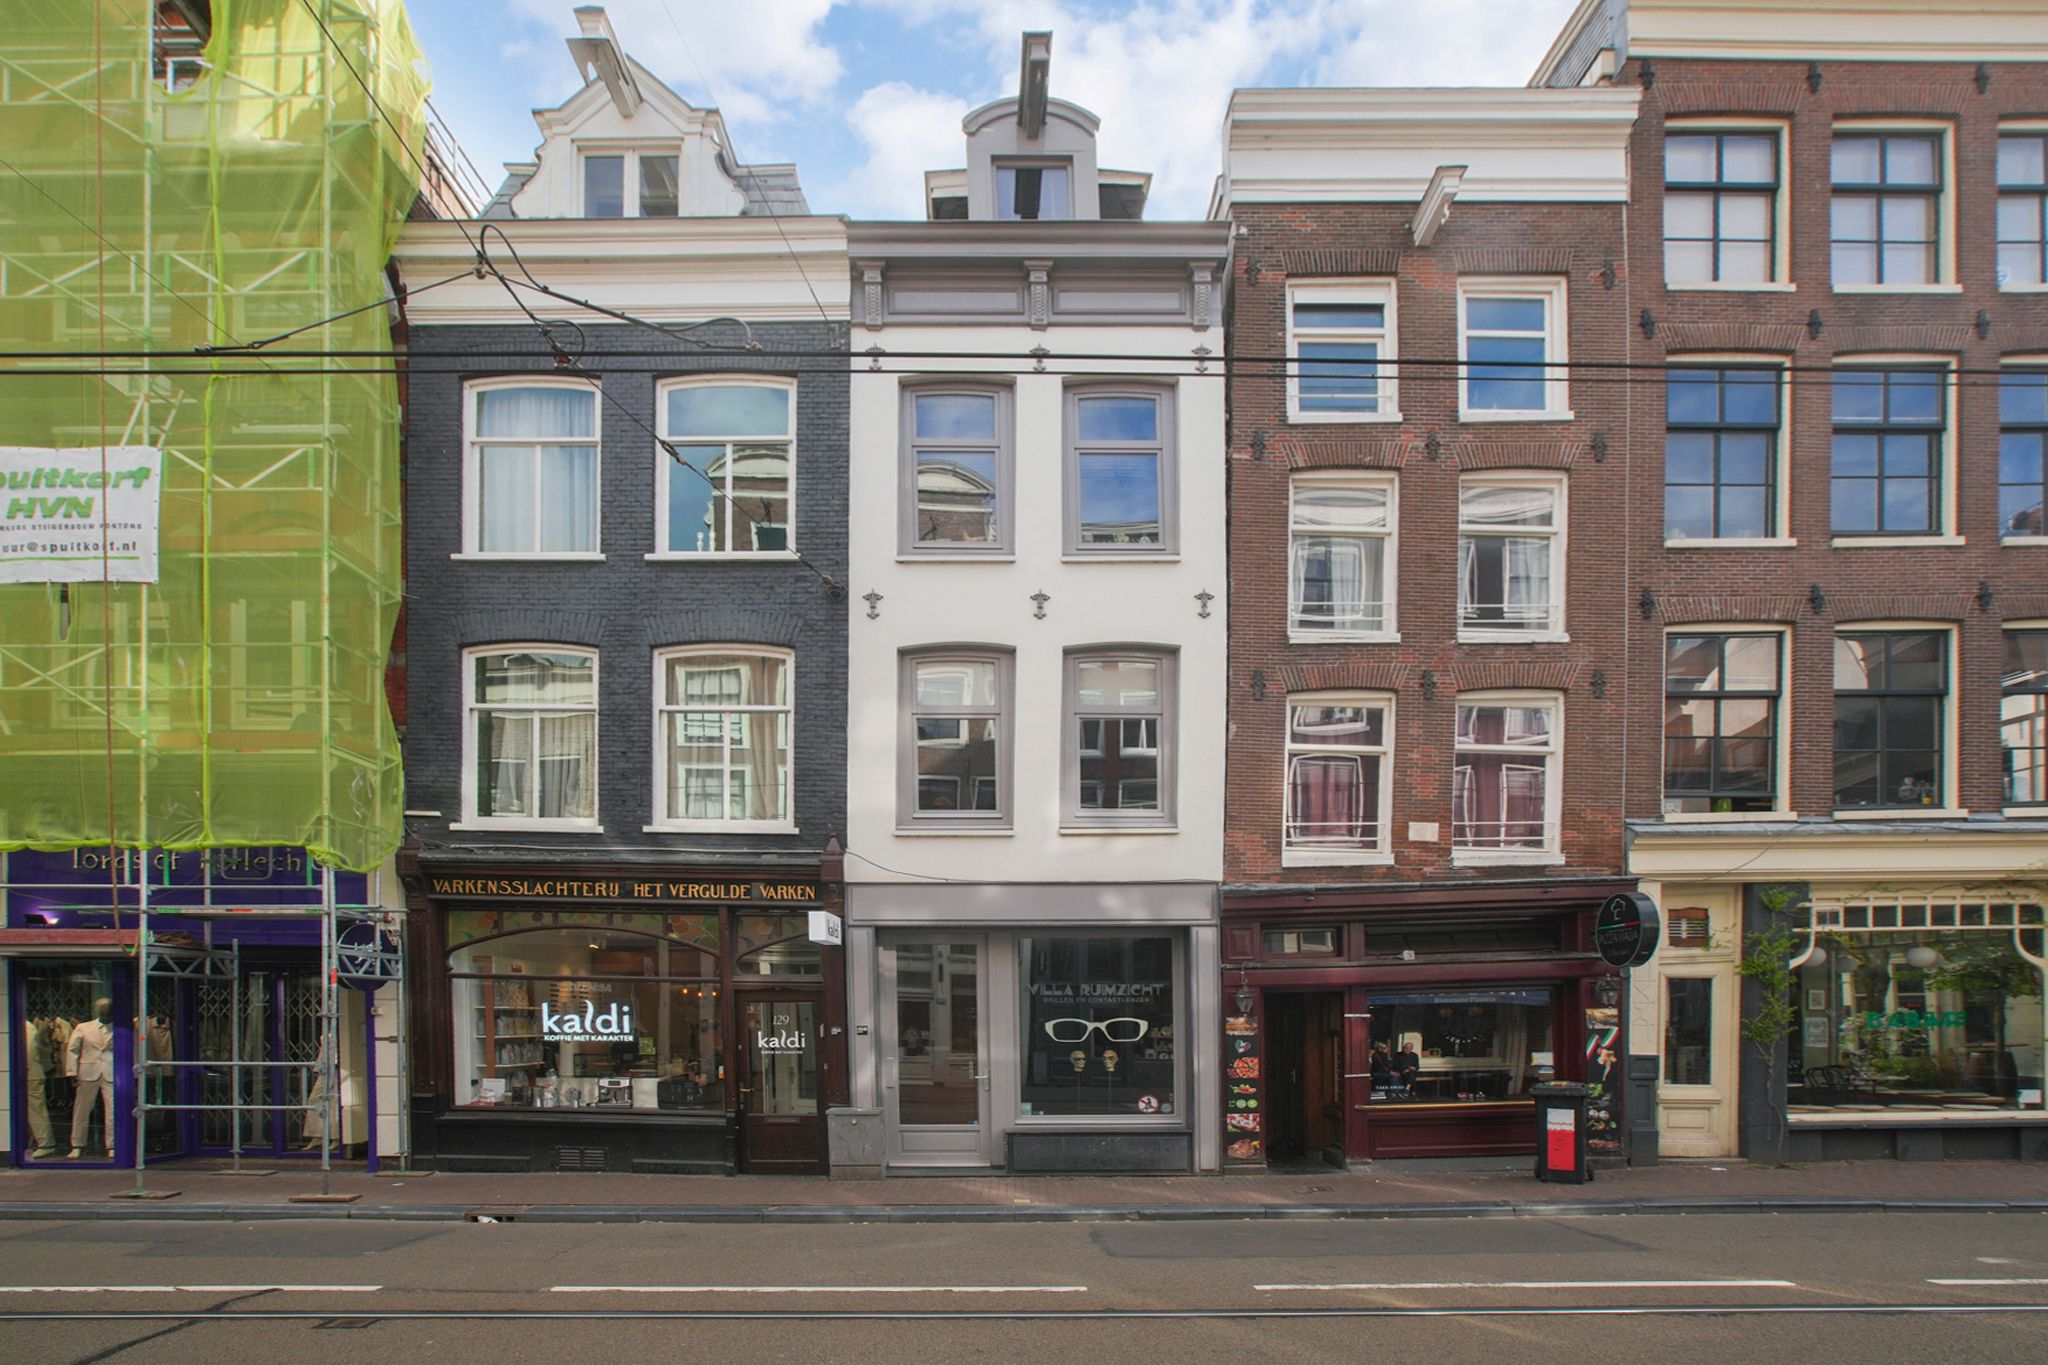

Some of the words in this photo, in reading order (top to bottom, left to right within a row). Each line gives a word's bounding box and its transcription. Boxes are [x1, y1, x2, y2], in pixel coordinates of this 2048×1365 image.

[0, 466, 152, 489] uitkorf
[6, 496, 95, 519] HVN
[432, 879, 620, 897] VARKENSSLACHTERIJ
[633, 883, 663, 898] HET
[669, 883, 750, 899] VERGULDE
[759, 884, 816, 900] VARKEN
[1028, 983, 1074, 996] VILLA
[1080, 983, 1164, 996] RUIMZICHT
[542, 999, 631, 1034] kaldi
[772, 1014, 790, 1025] 129
[591, 1034, 634, 1042] KARAKTER
[757, 1029, 806, 1048] kaldi
